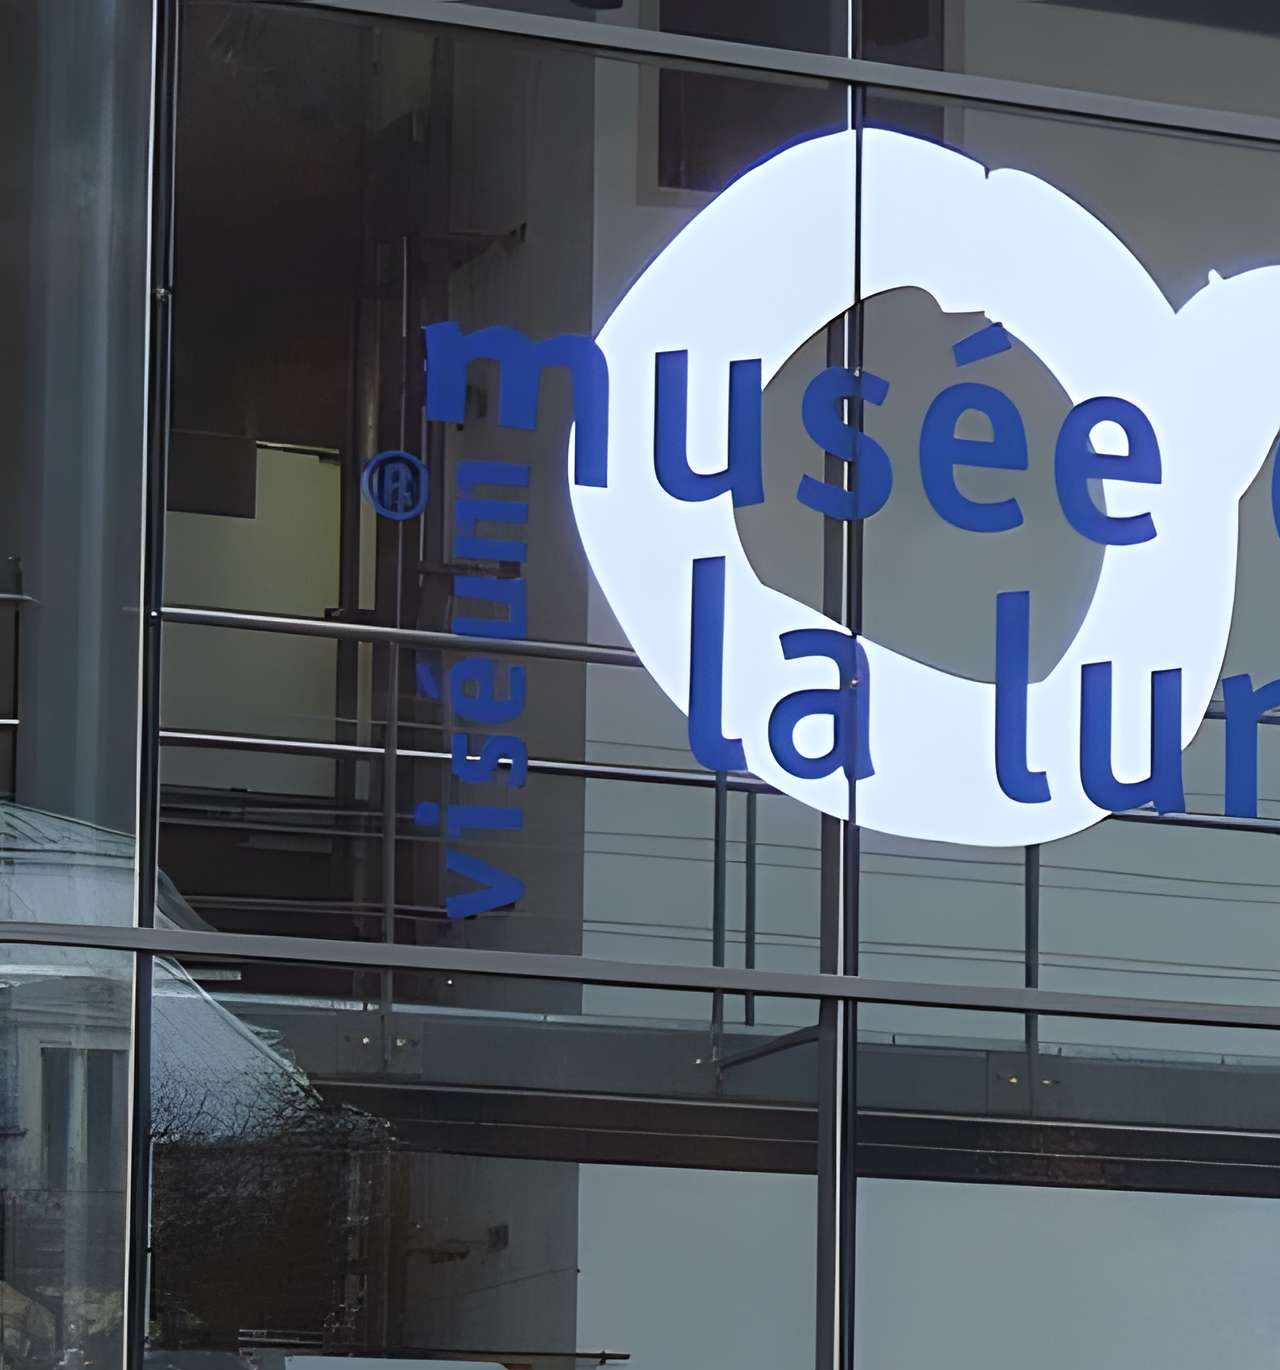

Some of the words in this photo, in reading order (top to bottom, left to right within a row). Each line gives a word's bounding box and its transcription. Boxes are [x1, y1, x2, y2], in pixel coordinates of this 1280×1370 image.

[424, 319, 1163, 547] musée
[414, 460, 529, 919] viséum
[686, 556, 877, 780] la
